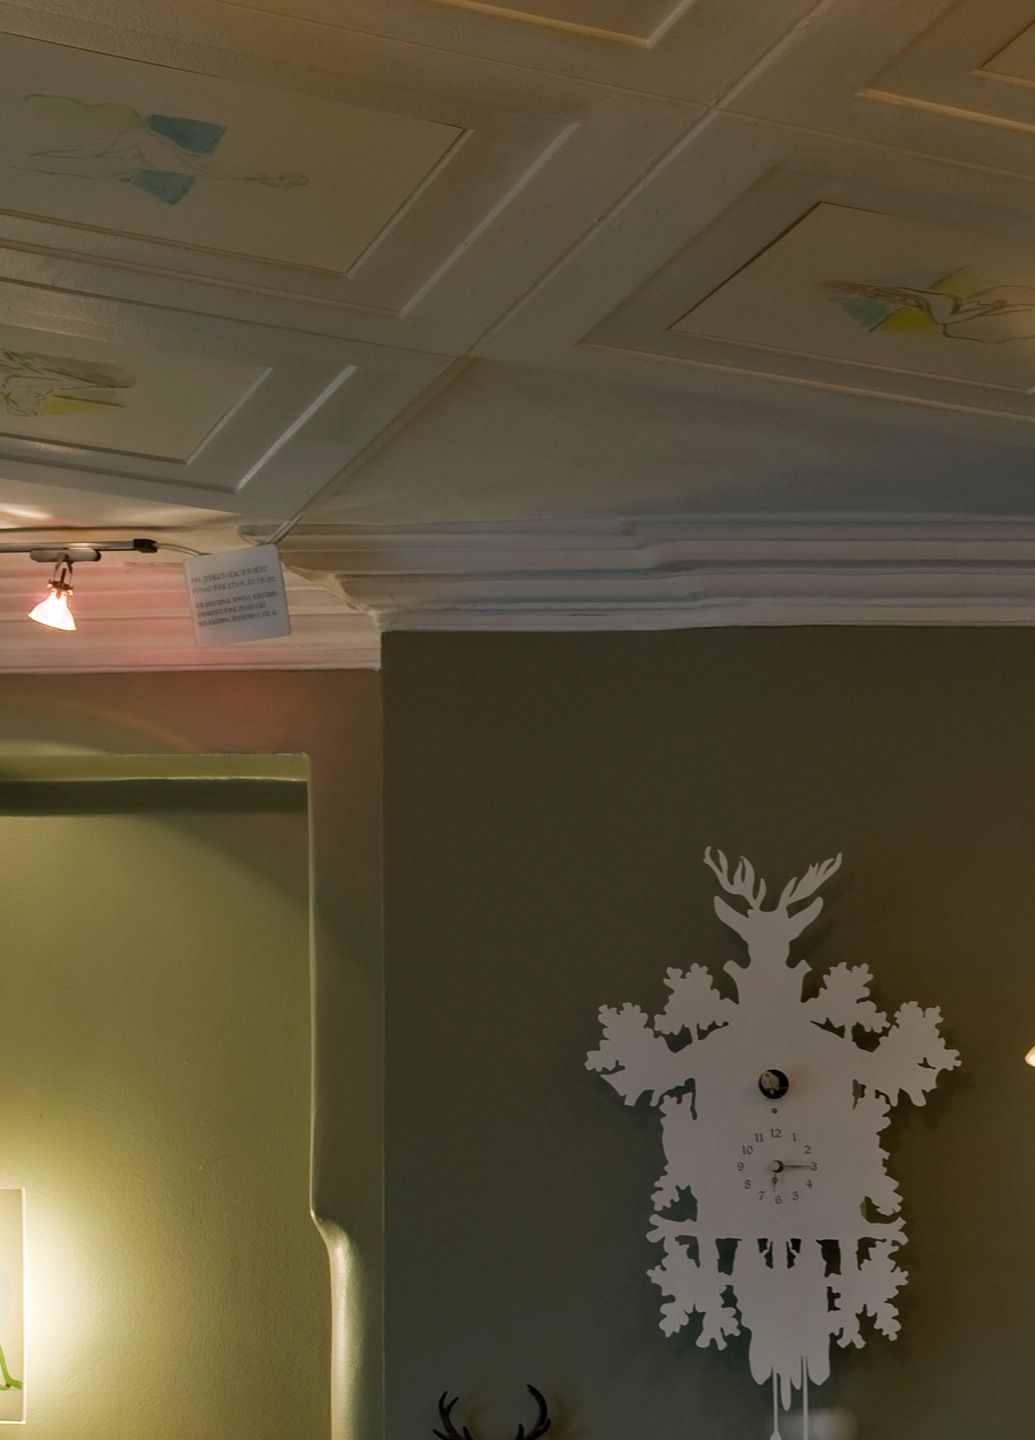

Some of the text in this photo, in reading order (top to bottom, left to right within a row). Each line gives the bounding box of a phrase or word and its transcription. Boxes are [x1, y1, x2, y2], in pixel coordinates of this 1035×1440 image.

[754, 1133, 764, 1142] 11
[770, 1128, 782, 1138] 12
[792, 1132, 797, 1142] 1
[742, 1145, 754, 1155] 10
[804, 1145, 811, 1154] 2
[737, 1162, 744, 1171] 9
[810, 1162, 818, 1171] 3
[744, 1180, 751, 1189] 8
[806, 1180, 813, 1189] 4
[758, 1191, 765, 1200] 7
[775, 1195, 782, 1204] 6
[792, 1191, 799, 1200] 5
